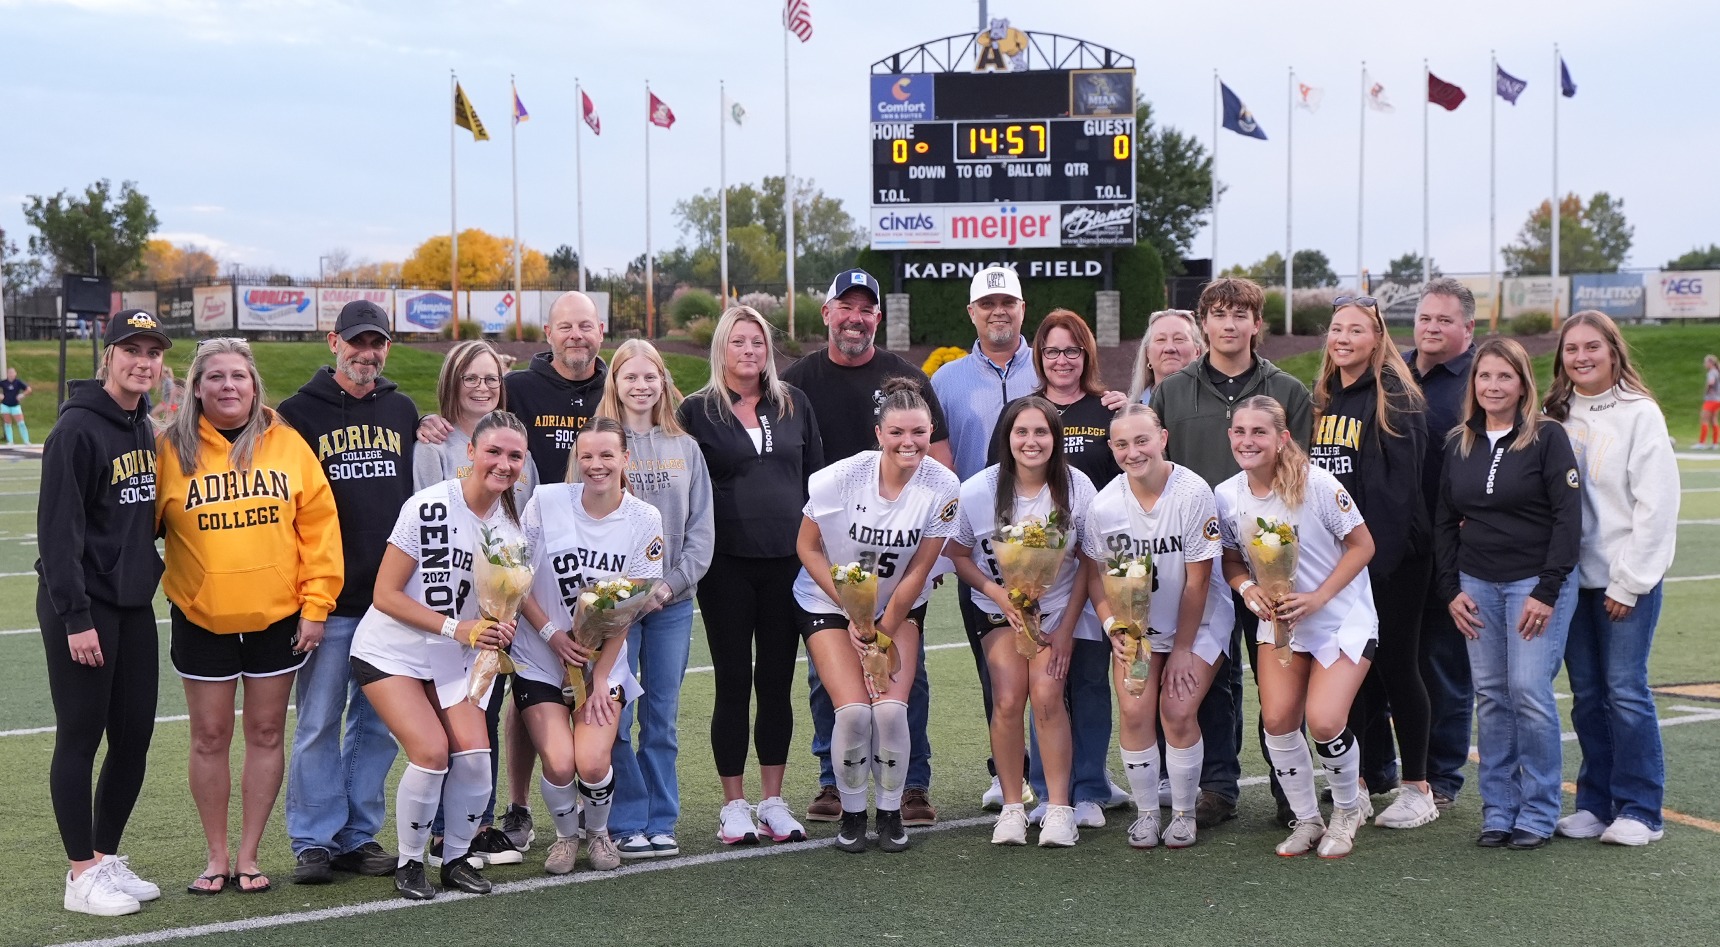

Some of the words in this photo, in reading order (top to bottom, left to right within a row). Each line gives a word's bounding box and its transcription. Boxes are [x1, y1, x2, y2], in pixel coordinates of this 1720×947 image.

[877, 100, 926, 113] Comfort
[872, 123, 915, 140] HOME
[1083, 119, 1133, 137] GUEST
[969, 125, 1045, 155] 14:57
[1113, 135, 1129, 160] 0
[892, 139, 907, 164] 0
[908, 166, 946, 179] DOWN
[956, 165, 972, 178] TO
[975, 165, 992, 178] GO
[1007, 164, 1034, 177] BALL
[1036, 163, 1051, 177] ON
[1064, 163, 1089, 176] QTR
[879, 189, 910, 202] T.O.L.
[1095, 185, 1127, 199] T.O.L.
[952, 206, 1051, 246] meijer
[1066, 206, 1134, 235] Bianco
[1030, 260, 1102, 277] FIELD
[1667, 279, 1703, 295] AEG
[534, 415, 575, 428] ADRIAN
[555, 430, 579, 443] SOC
[760, 414, 773, 453] BULLDOGS
[1063, 426, 1106, 436] COLLEGE
[318, 424, 402, 463] ADRIAN
[341, 450, 383, 462] COLLEGE
[1310, 455, 1354, 475] OCCER
[328, 460, 397, 481] SOCCER
[1486, 447, 1504, 495] BULLDOGS
[183, 467, 291, 513] ADRIAN
[197, 505, 280, 531] COLLEGE
[849, 522, 922, 548] ADRIAN
[1133, 535, 1183, 557] RIAN
[577, 547, 627, 573] RIAN
[422, 571, 451, 584] 2027
[1327, 738, 1347, 756] C
[590, 789, 608, 800] C
